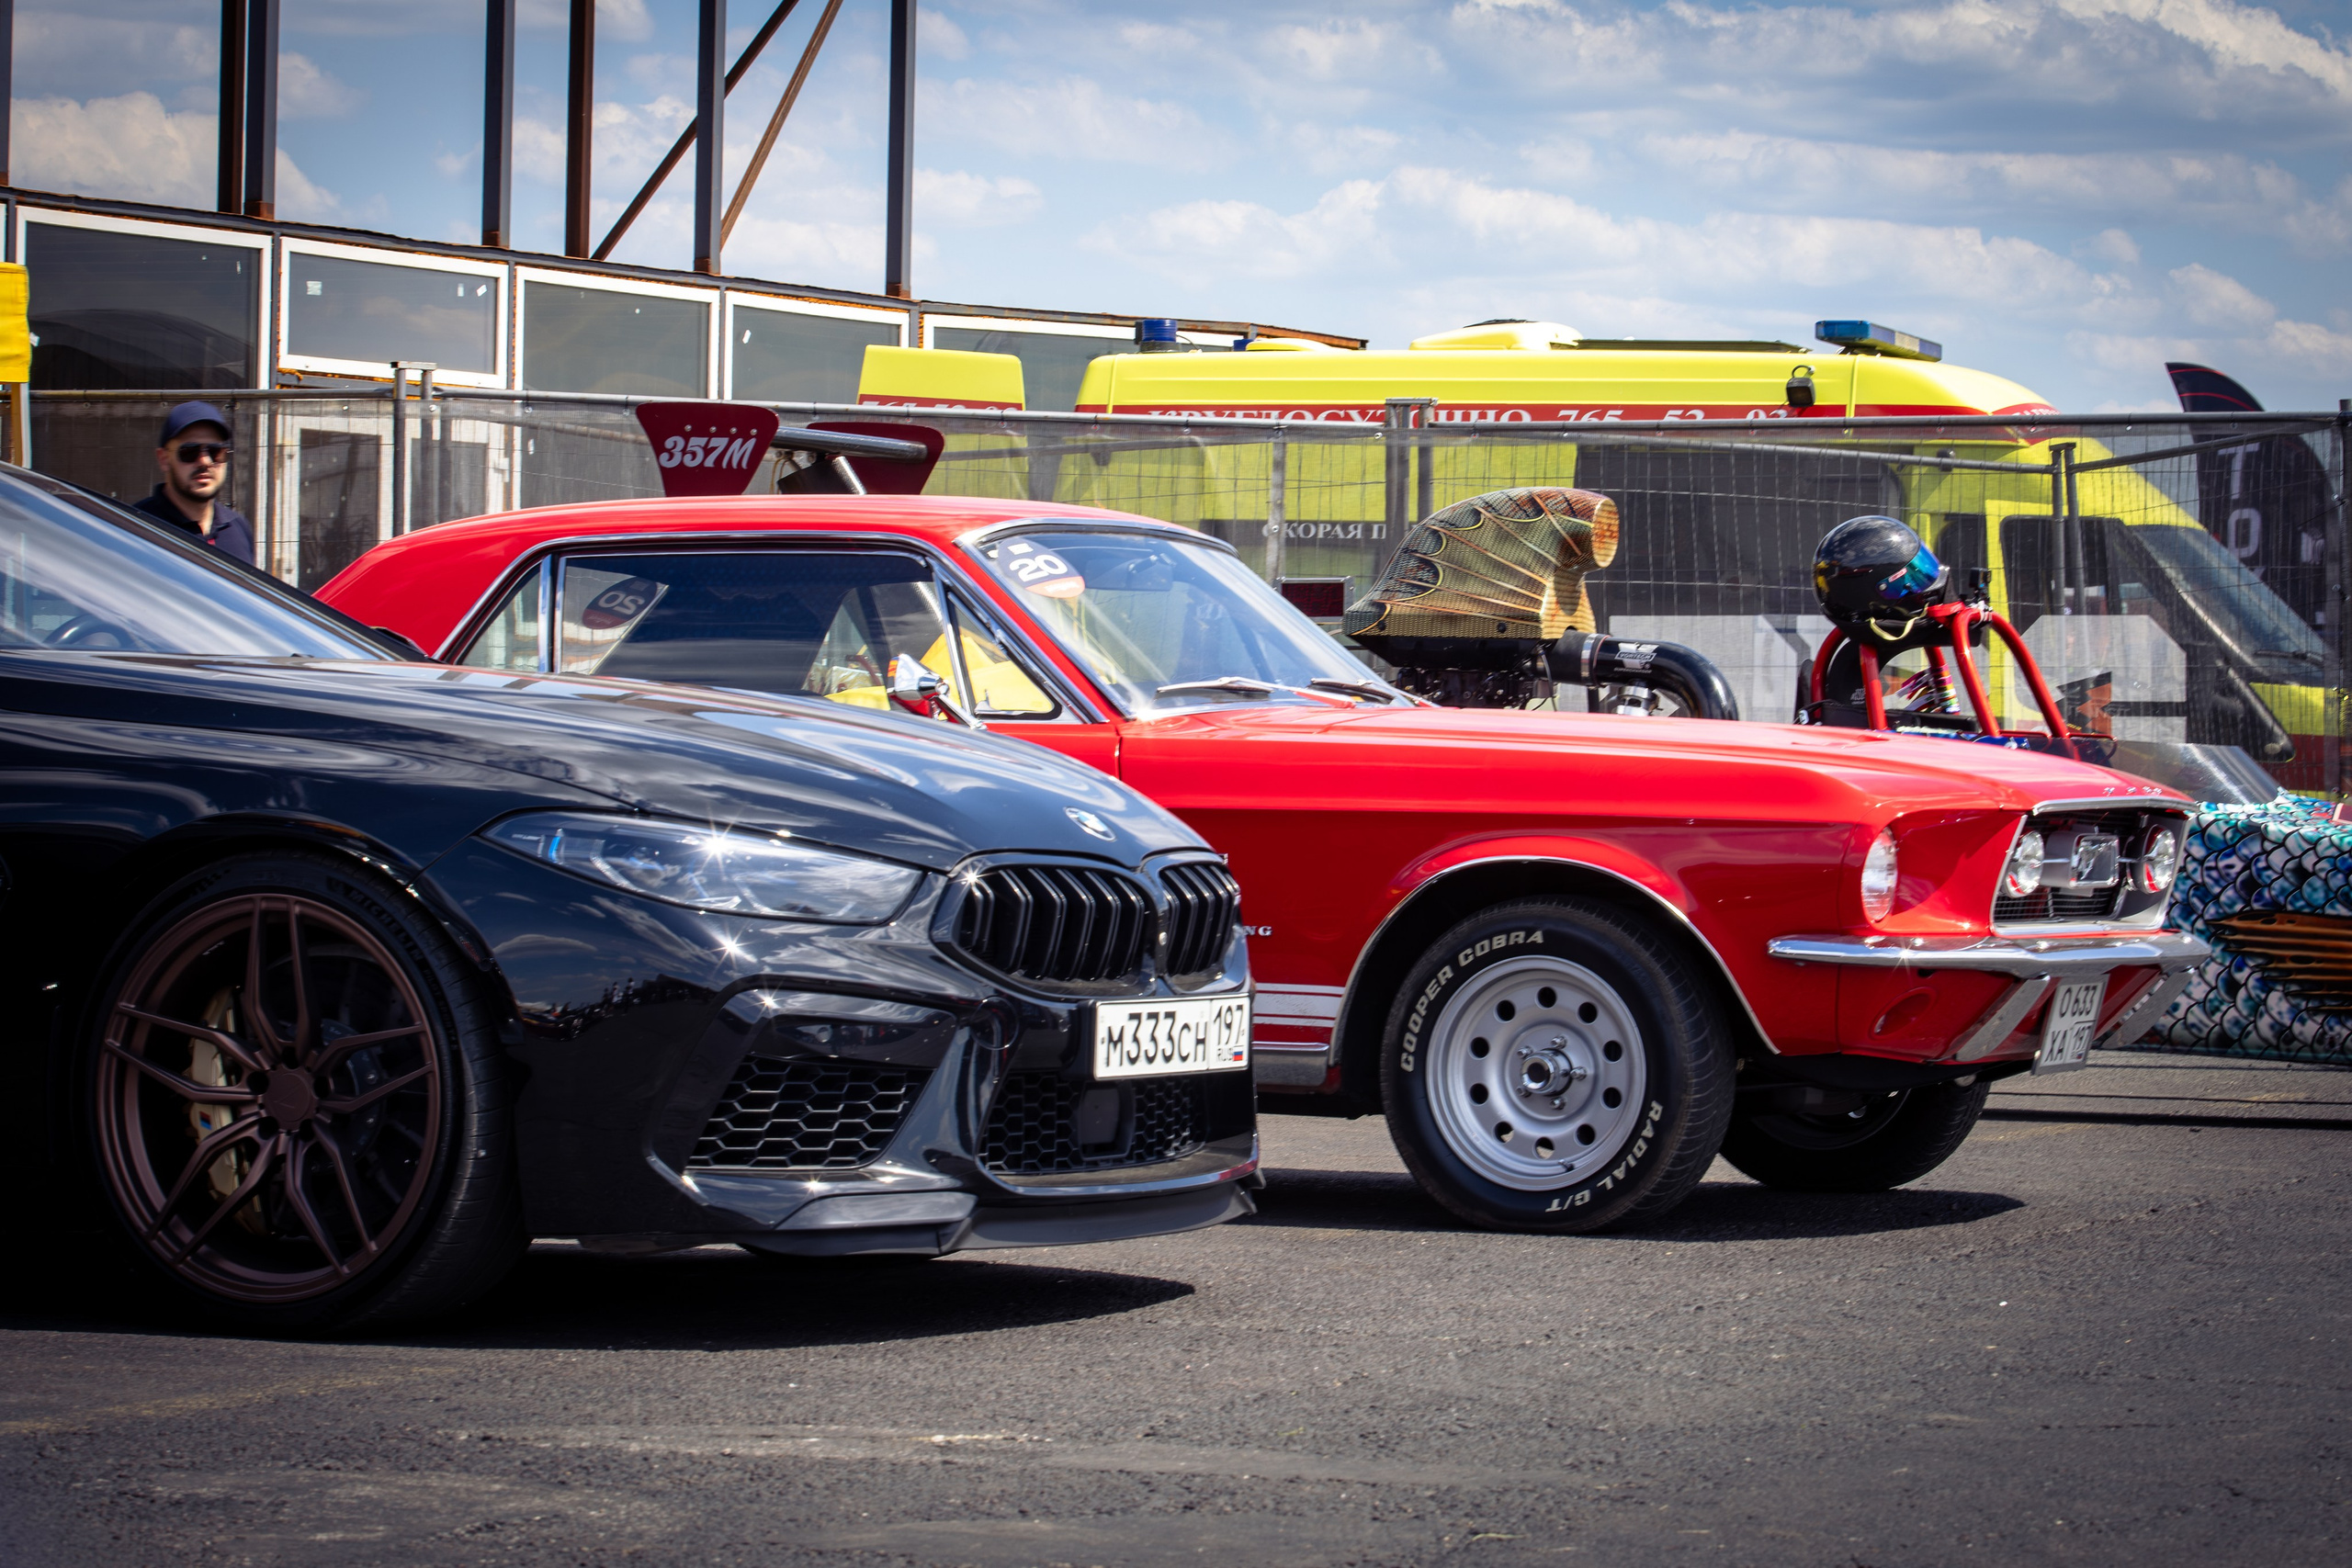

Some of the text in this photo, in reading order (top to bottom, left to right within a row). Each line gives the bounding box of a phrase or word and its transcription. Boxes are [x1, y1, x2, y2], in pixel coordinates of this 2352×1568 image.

[659, 435, 757, 469] 357M
[1009, 554, 1068, 582] 20
[348, 886, 424, 962] MICHELIN
[1213, 1004, 1244, 1046] 197
[1400, 931, 1544, 1072] COOPER COBRA
[1544, 1100, 1664, 1213] RADIAL G/T
